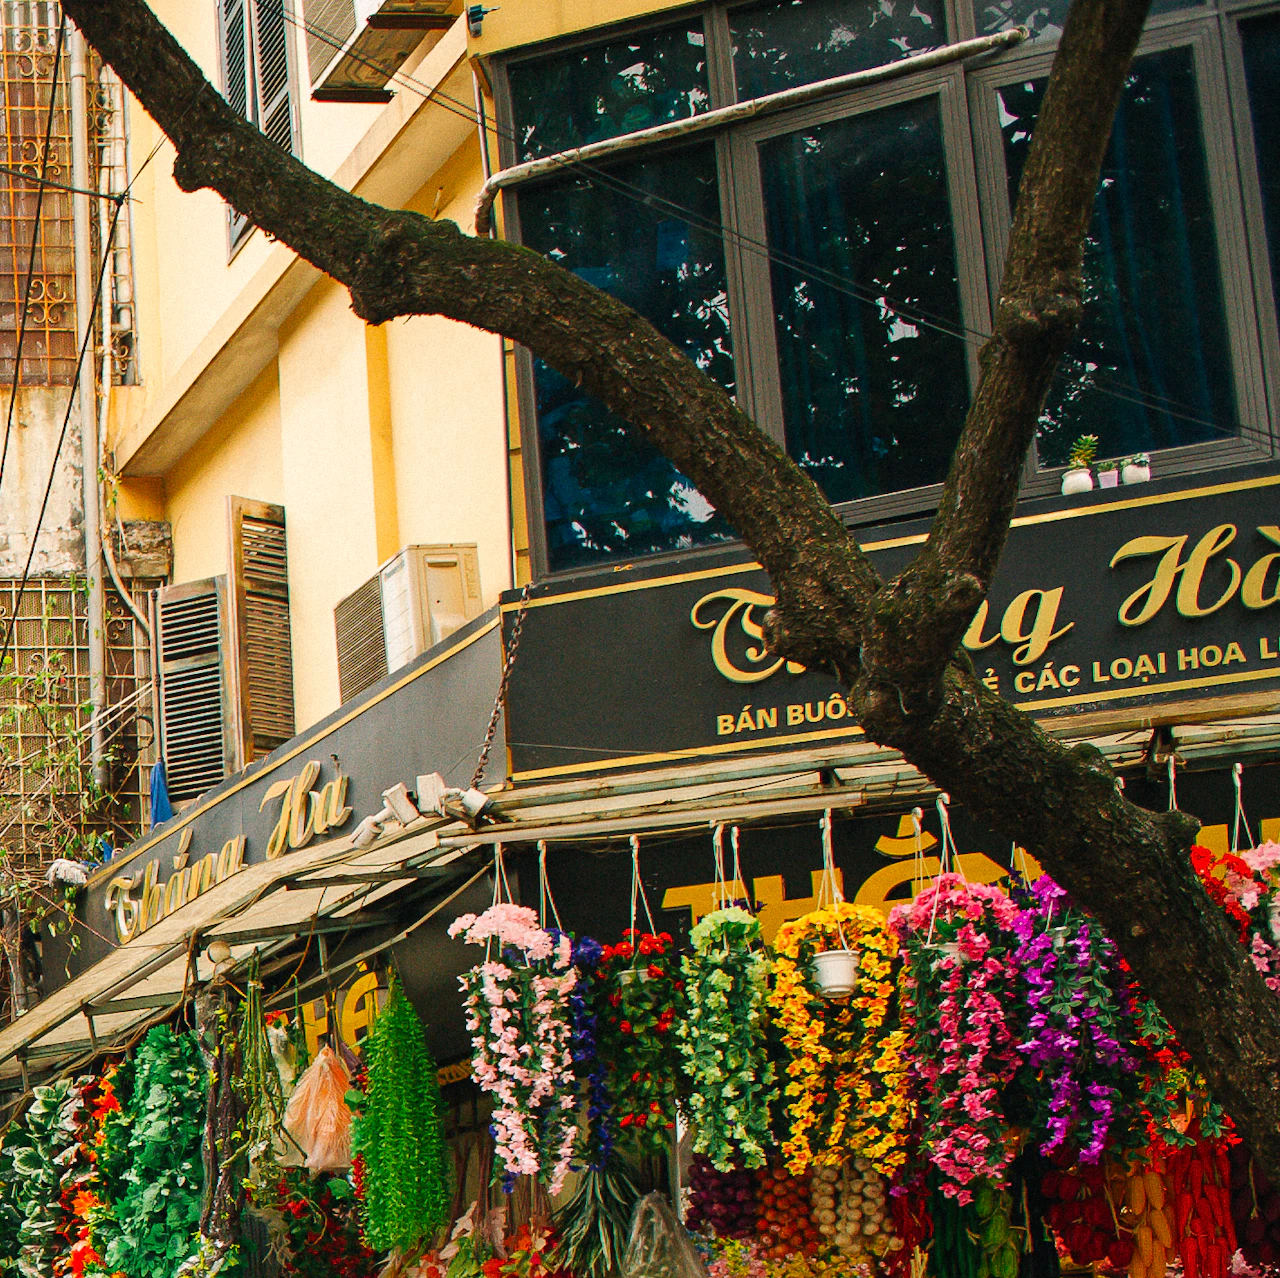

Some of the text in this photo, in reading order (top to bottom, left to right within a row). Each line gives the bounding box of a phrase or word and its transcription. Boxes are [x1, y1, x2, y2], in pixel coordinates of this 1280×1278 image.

[716, 704, 778, 736] BÁN
[786, 693, 855, 726] BUÔ
[1014, 662, 1080, 693] CÁC
[1093, 652, 1167, 683] LOẠI
[1177, 642, 1247, 671] HOA
